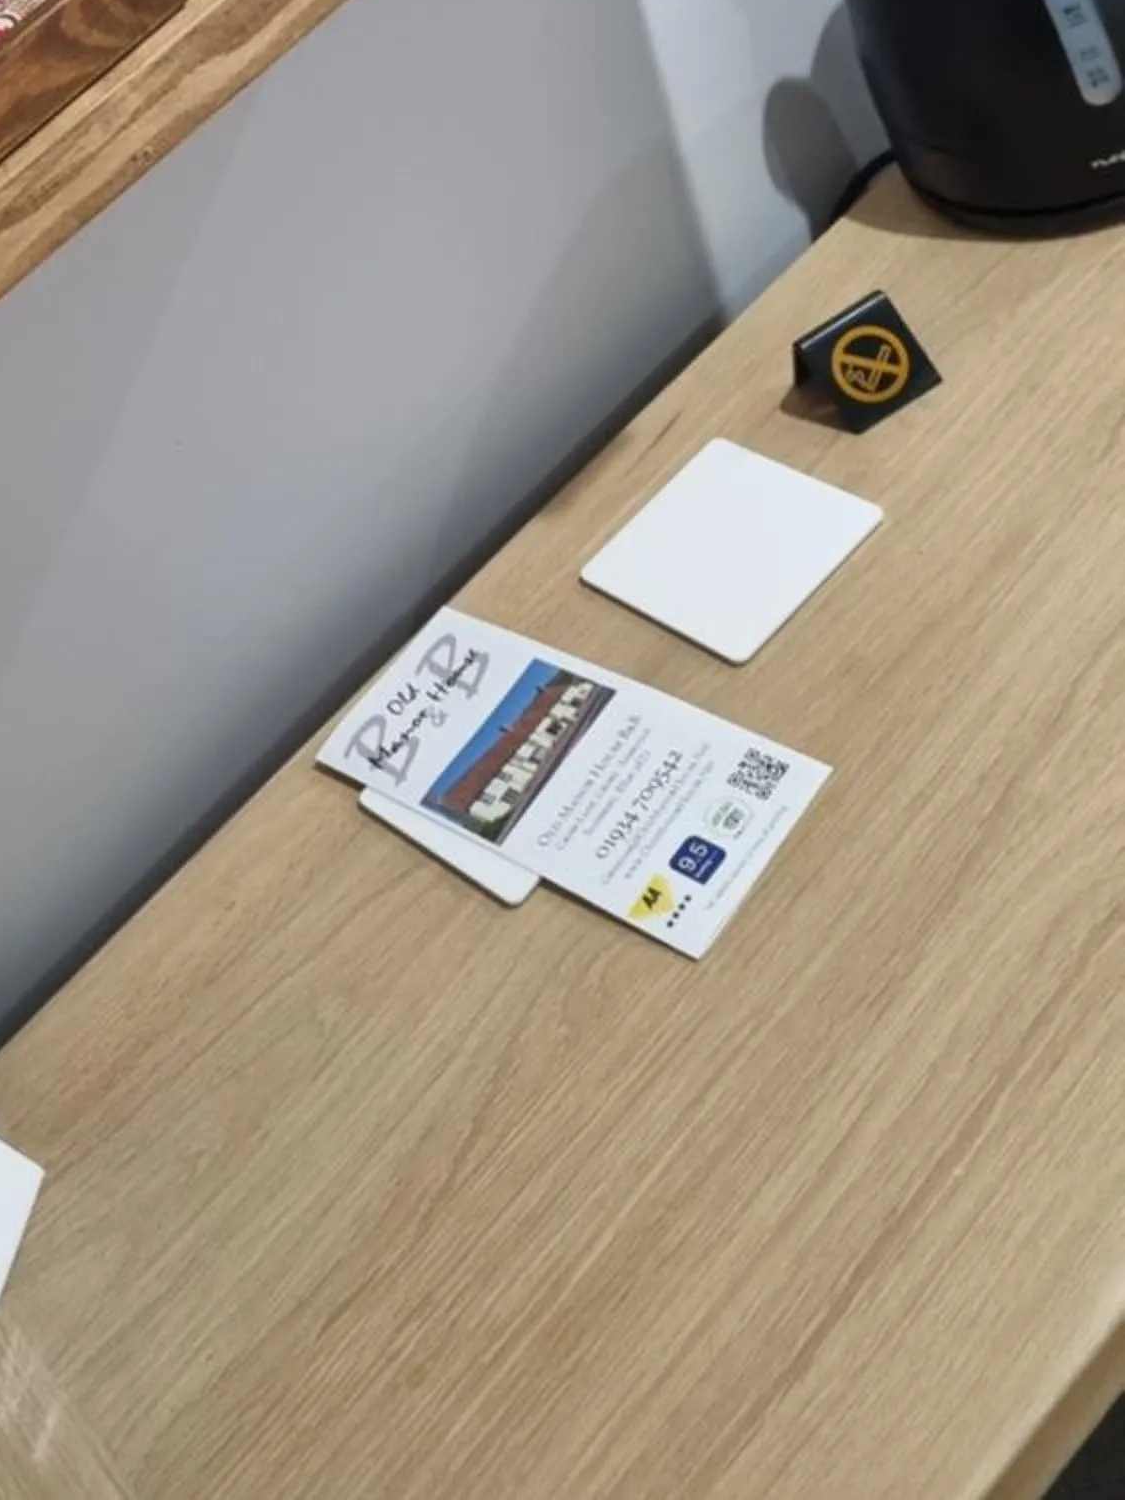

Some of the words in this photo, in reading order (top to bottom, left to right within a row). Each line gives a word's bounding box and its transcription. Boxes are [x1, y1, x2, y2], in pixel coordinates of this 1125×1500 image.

[386, 683, 419, 716] Old
[593, 808, 639, 862] 01934
[677, 838, 709, 874] 9.5
[640, 884, 662, 909] AA
